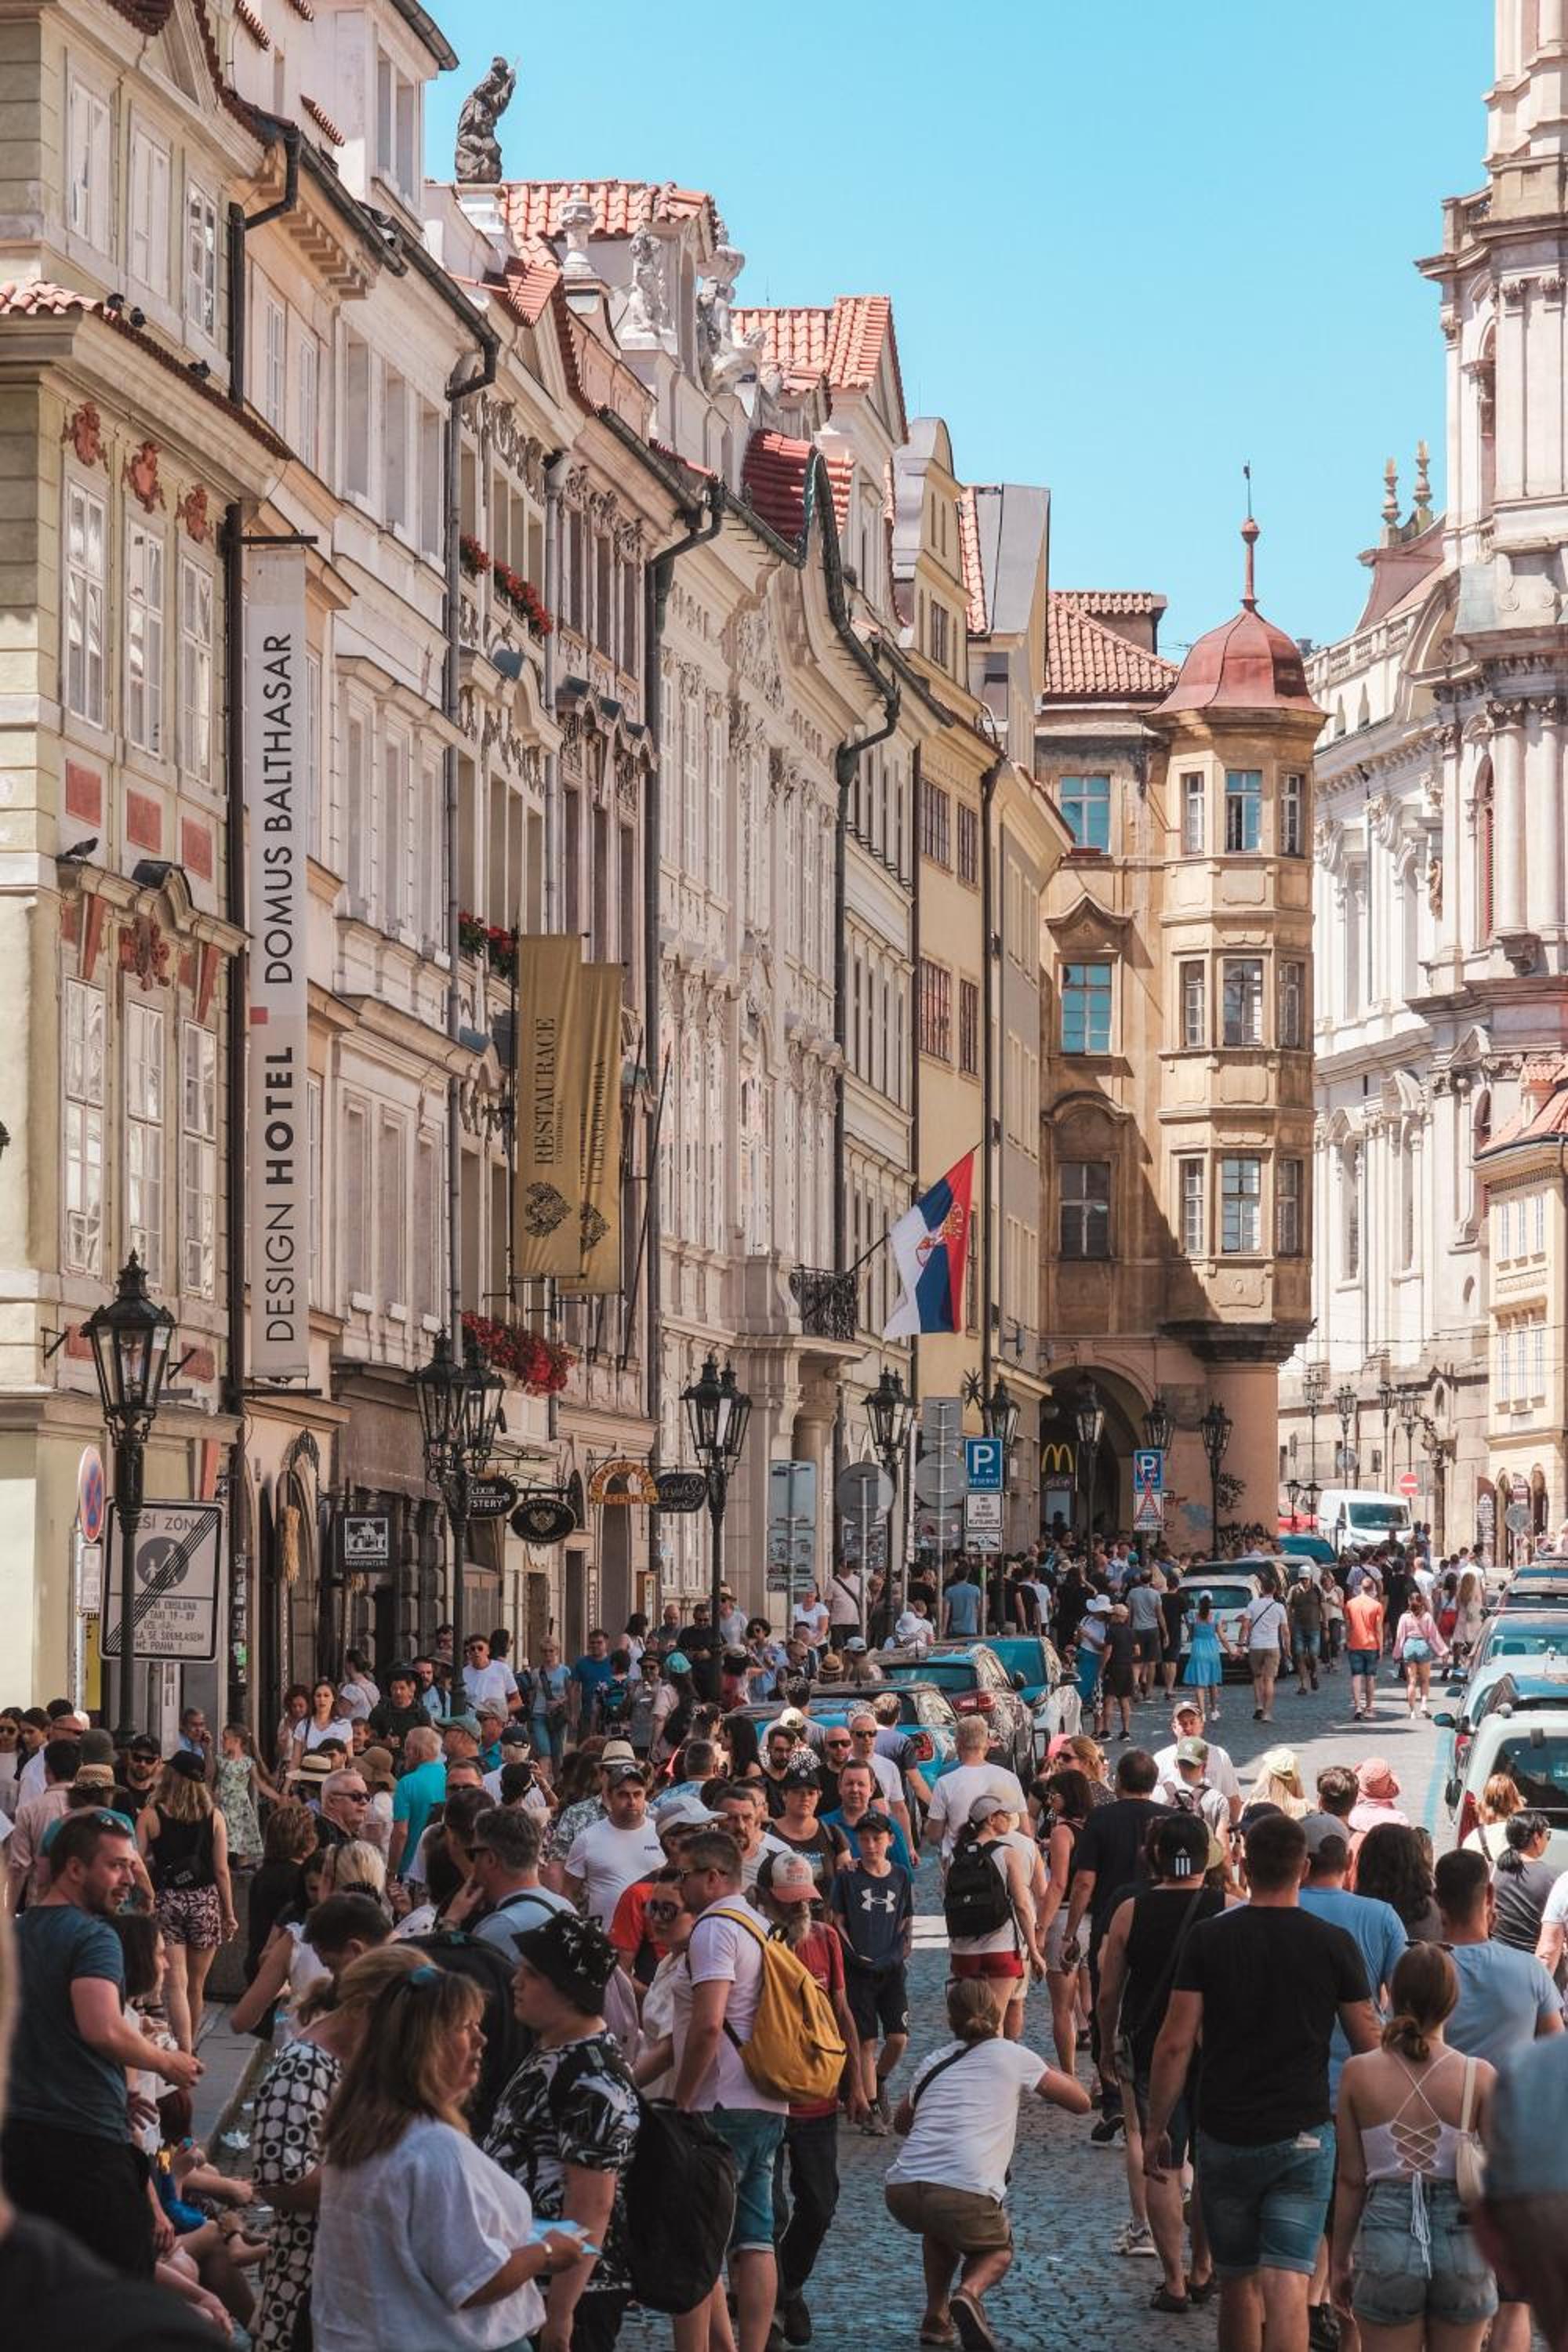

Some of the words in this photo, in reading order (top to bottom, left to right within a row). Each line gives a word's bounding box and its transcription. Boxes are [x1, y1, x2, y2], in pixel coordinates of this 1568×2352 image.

[263, 633, 292, 832] BALTHASAR
[263, 846, 292, 984] DOMUS
[265, 1047, 294, 1185] HOTEL
[535, 1018, 554, 1166] RESTAURACE
[265, 1203, 295, 1342] DESIGN
[470, 1498, 503, 1508] STERY
[471, 1486, 496, 1495] LIXIR
[974, 1445, 994, 1475] P
